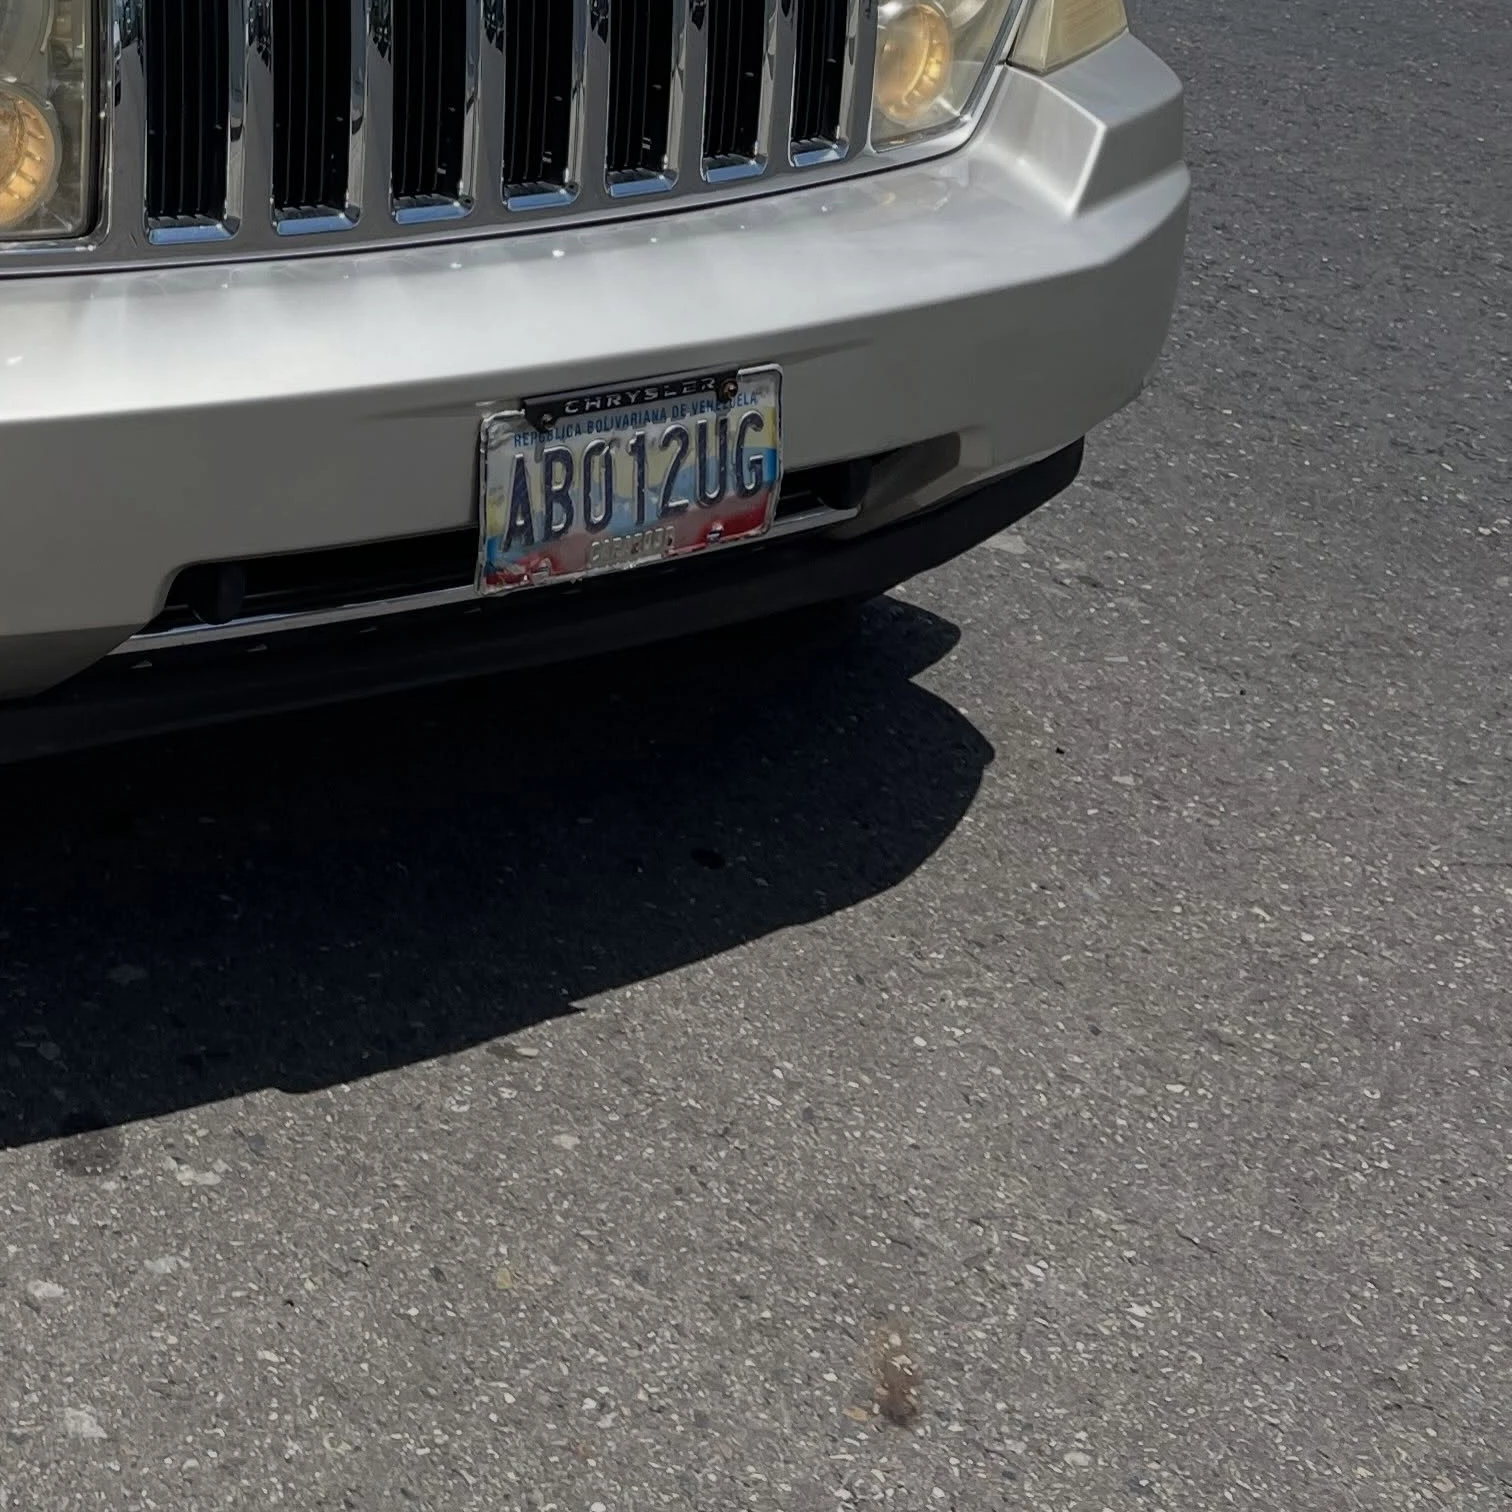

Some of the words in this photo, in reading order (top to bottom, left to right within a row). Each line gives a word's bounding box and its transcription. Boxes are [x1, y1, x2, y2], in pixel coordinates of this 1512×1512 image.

[564, 378, 716, 415] CHRYSLER
[587, 406, 667, 434] BOLIVARIANA
[672, 402, 688, 421] DE
[501, 409, 765, 553] AB012UG
